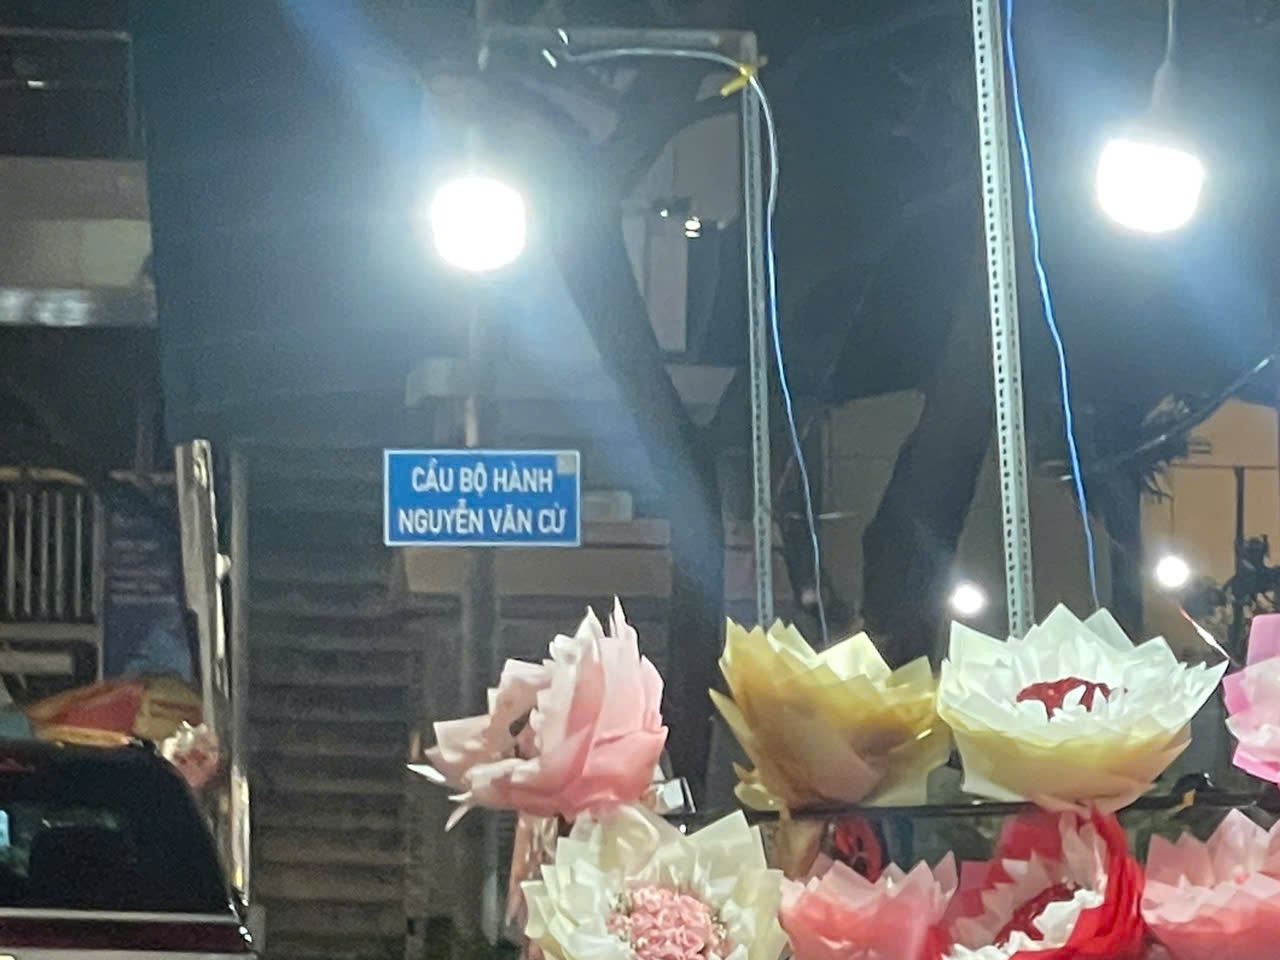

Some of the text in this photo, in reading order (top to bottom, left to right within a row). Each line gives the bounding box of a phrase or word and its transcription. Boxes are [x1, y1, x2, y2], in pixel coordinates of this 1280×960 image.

[411, 458, 553, 497] CẦU BỘ HÀNH
[398, 498, 567, 534] NGUYỄN VĂN CỪ
